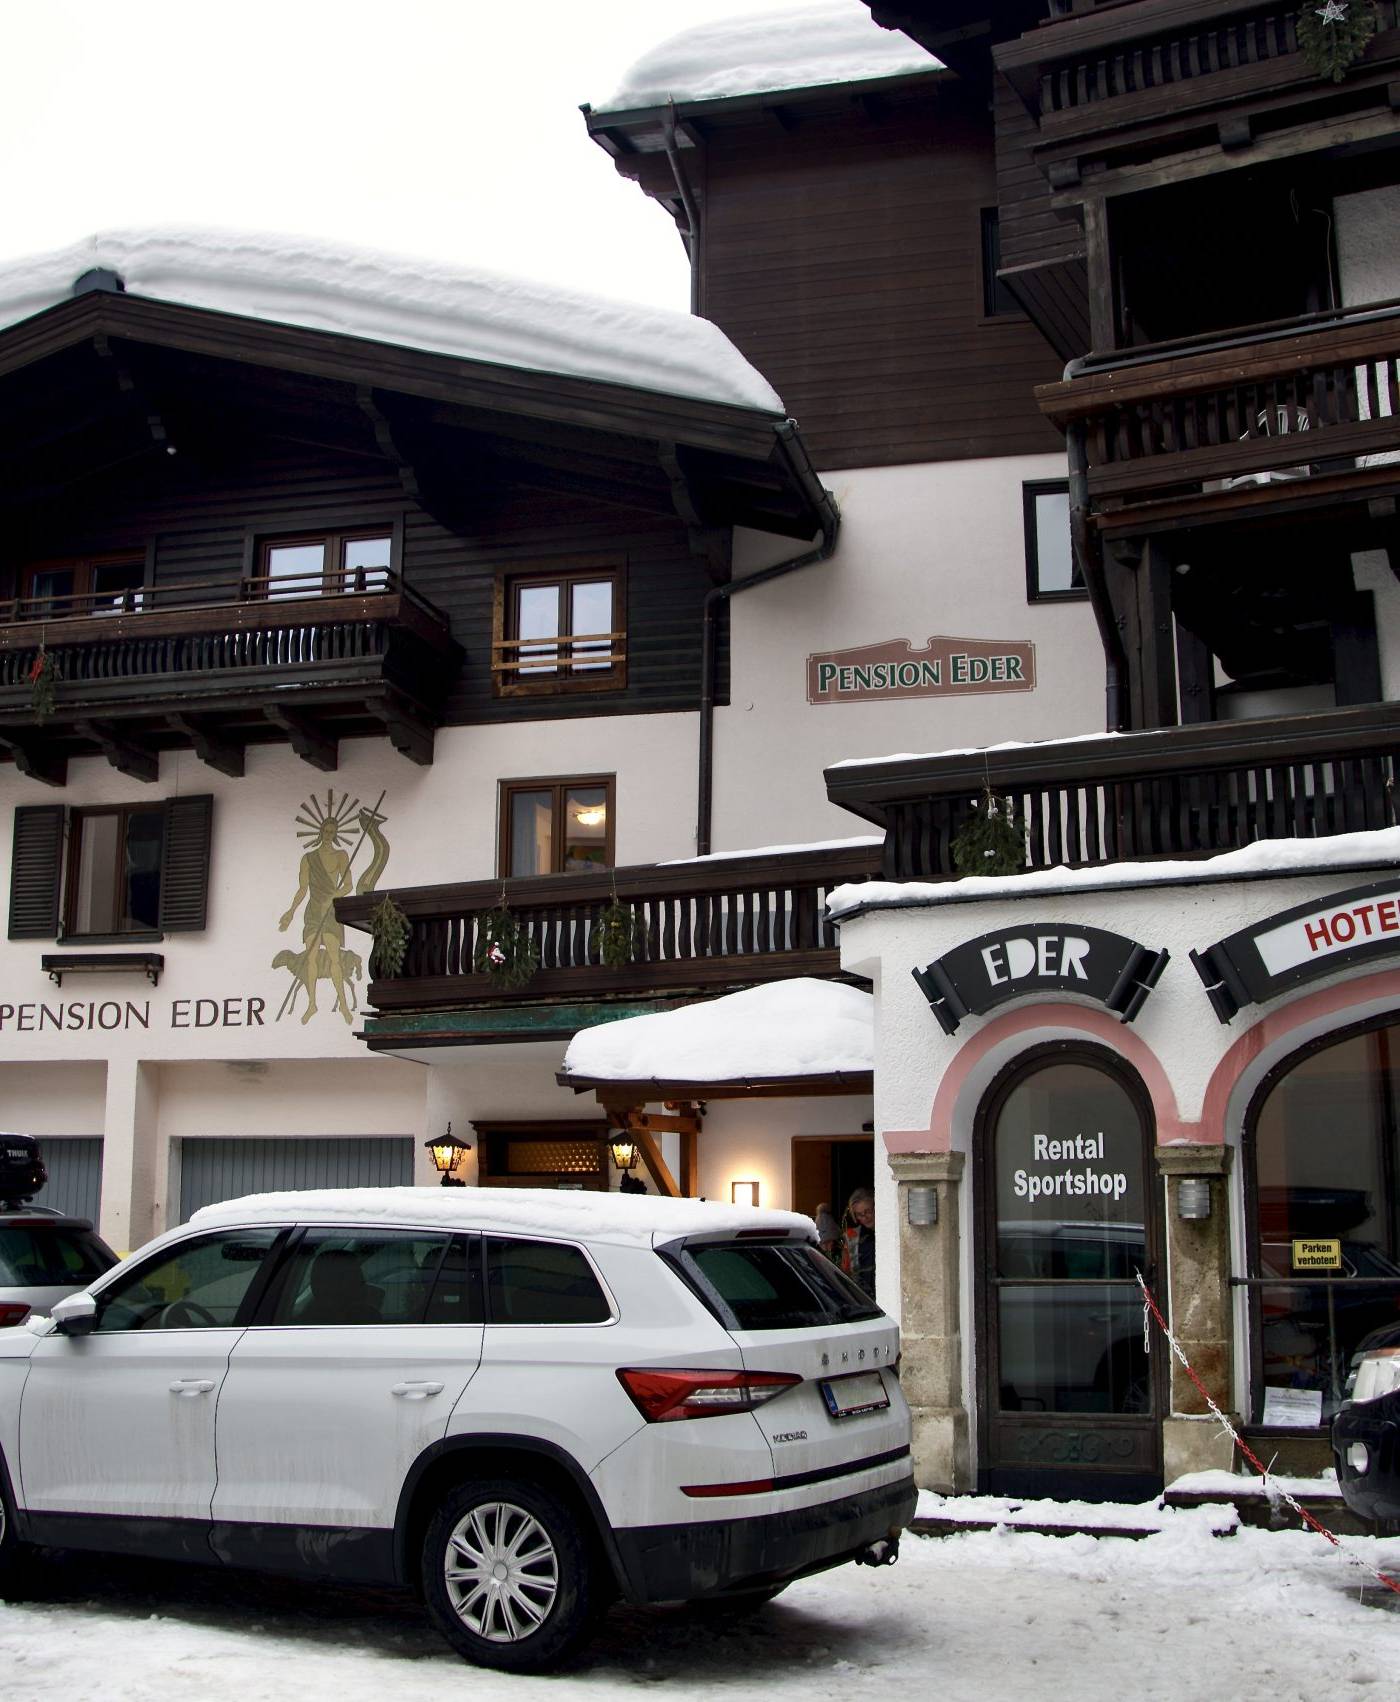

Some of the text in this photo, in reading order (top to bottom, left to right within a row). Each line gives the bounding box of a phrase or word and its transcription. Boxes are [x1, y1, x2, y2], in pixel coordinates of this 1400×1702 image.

[818, 653, 1025, 693] PENSION EDER
[1304, 899, 1400, 952] HOTE
[981, 936, 1090, 987] EDER
[0, 997, 266, 1031] PENSION EDER
[1033, 1132, 1104, 1161] Rental
[1014, 1168, 1127, 1203] Sportshop
[1297, 1256, 1337, 1265] verboten!
[1302, 1243, 1332, 1253] Parken
